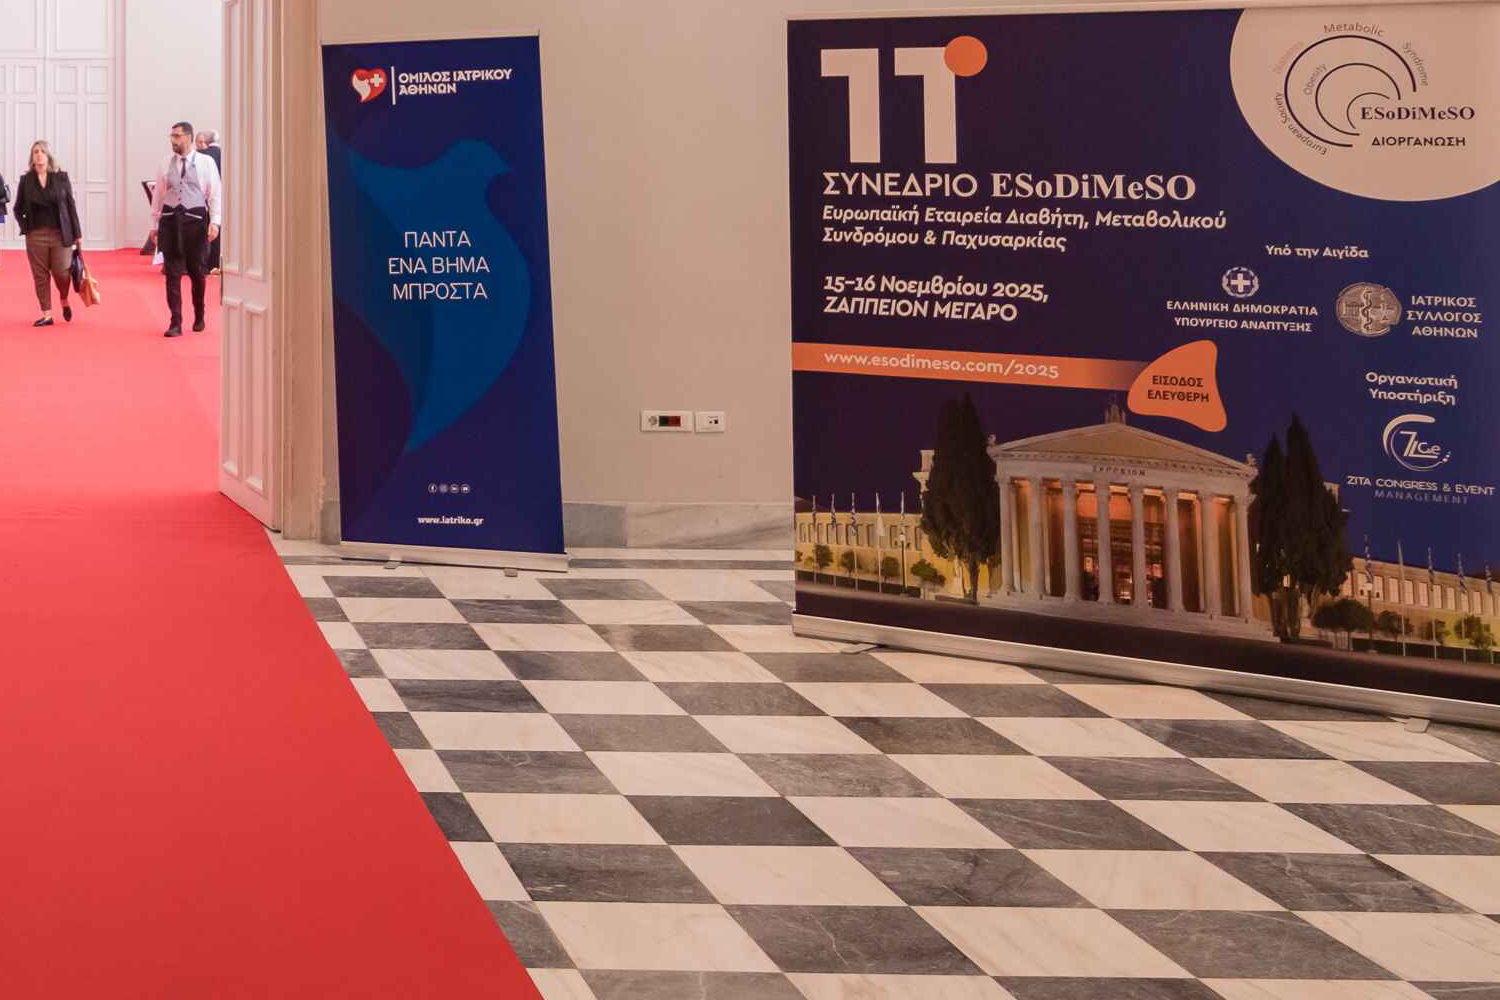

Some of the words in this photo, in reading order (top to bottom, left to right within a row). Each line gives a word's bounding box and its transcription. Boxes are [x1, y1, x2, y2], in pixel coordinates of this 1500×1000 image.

[1324, 22, 1385, 37] Metabolic
[1402, 42, 1428, 87] Syndrome
[398, 71, 451, 83] ΟΜΙΛΟΣ
[454, 69, 512, 81] ΙΑΤΡΙΚΟΥ
[399, 83, 457, 95] ΑΘΗΝΩΝ
[1360, 106, 1476, 120] ESoDiMeSO
[1371, 136, 1466, 147] ΔΙΟΡΓΑΝΩΣΗ
[823, 171, 978, 198] ΣΥΝΕΔΡΙΟ
[991, 172, 1196, 201] ESoDiMeSO
[822, 204, 920, 225] Ευρωπαϊκή
[924, 207, 1002, 226] Εταιρεία
[1006, 208, 1089, 230] Διαβήτη,
[1095, 210, 1227, 230] Μεταβολικού
[404, 231, 471, 248] ΠΑΝΤΑ
[822, 227, 919, 247] Συνδρόμου
[924, 229, 936, 245] &
[941, 230, 1067, 252] Παχυσαρκίας
[1265, 245, 1292, 257] Υπό
[1295, 246, 1319, 258] την
[1323, 246, 1369, 259] Αιγίδα
[388, 257, 427, 275] ΕΝΑ
[432, 256, 490, 274] ΒΗΜΑ
[393, 282, 488, 300] ΜΠΡΟΣΤΑ
[880, 276, 988, 300] Νοεμβρίου
[992, 281, 1049, 303] 2025,
[823, 297, 930, 318] ΖΑΠΠΕΙΟΝ
[933, 300, 1018, 321] ΜΕΓΑΡΟ
[1166, 301, 1229, 312] ΕΛΛΗΝΙΚΗ
[1232, 303, 1318, 316] ΔΗΜΟΚΡΑΤΙΑ
[1412, 296, 1476, 308] ΙΑΤΡΙΚΟΣ
[1406, 310, 1483, 323] ΣΥΛΛΟΓΟΣ
[1174, 317, 1238, 329] ΥΠΟΥΡΓΕΙΟ
[1241, 320, 1312, 332] ΑΝΑΠΤΥΞΗΣ
[1412, 326, 1478, 338] ΑΘΗΝΩΝ
[824, 351, 1060, 380] www.esodimeso.com/2025
[1152, 375, 1204, 388] ΕΙΣΟΔΟΣ
[1365, 371, 1458, 389] Οργανωτική
[1147, 389, 1209, 403] ΕΛΕΥΘΕΡΗ
[1369, 388, 1456, 406] Υποστήριξη
[1347, 475, 1372, 487] ZITA
[1375, 478, 1437, 492] CONGRESS
[1443, 482, 1451, 491] &
[1455, 484, 1495, 496] EVENT
[1374, 490, 1468, 505] MANAGEMENT
[417, 515, 484, 526] www.iatriko.gr
